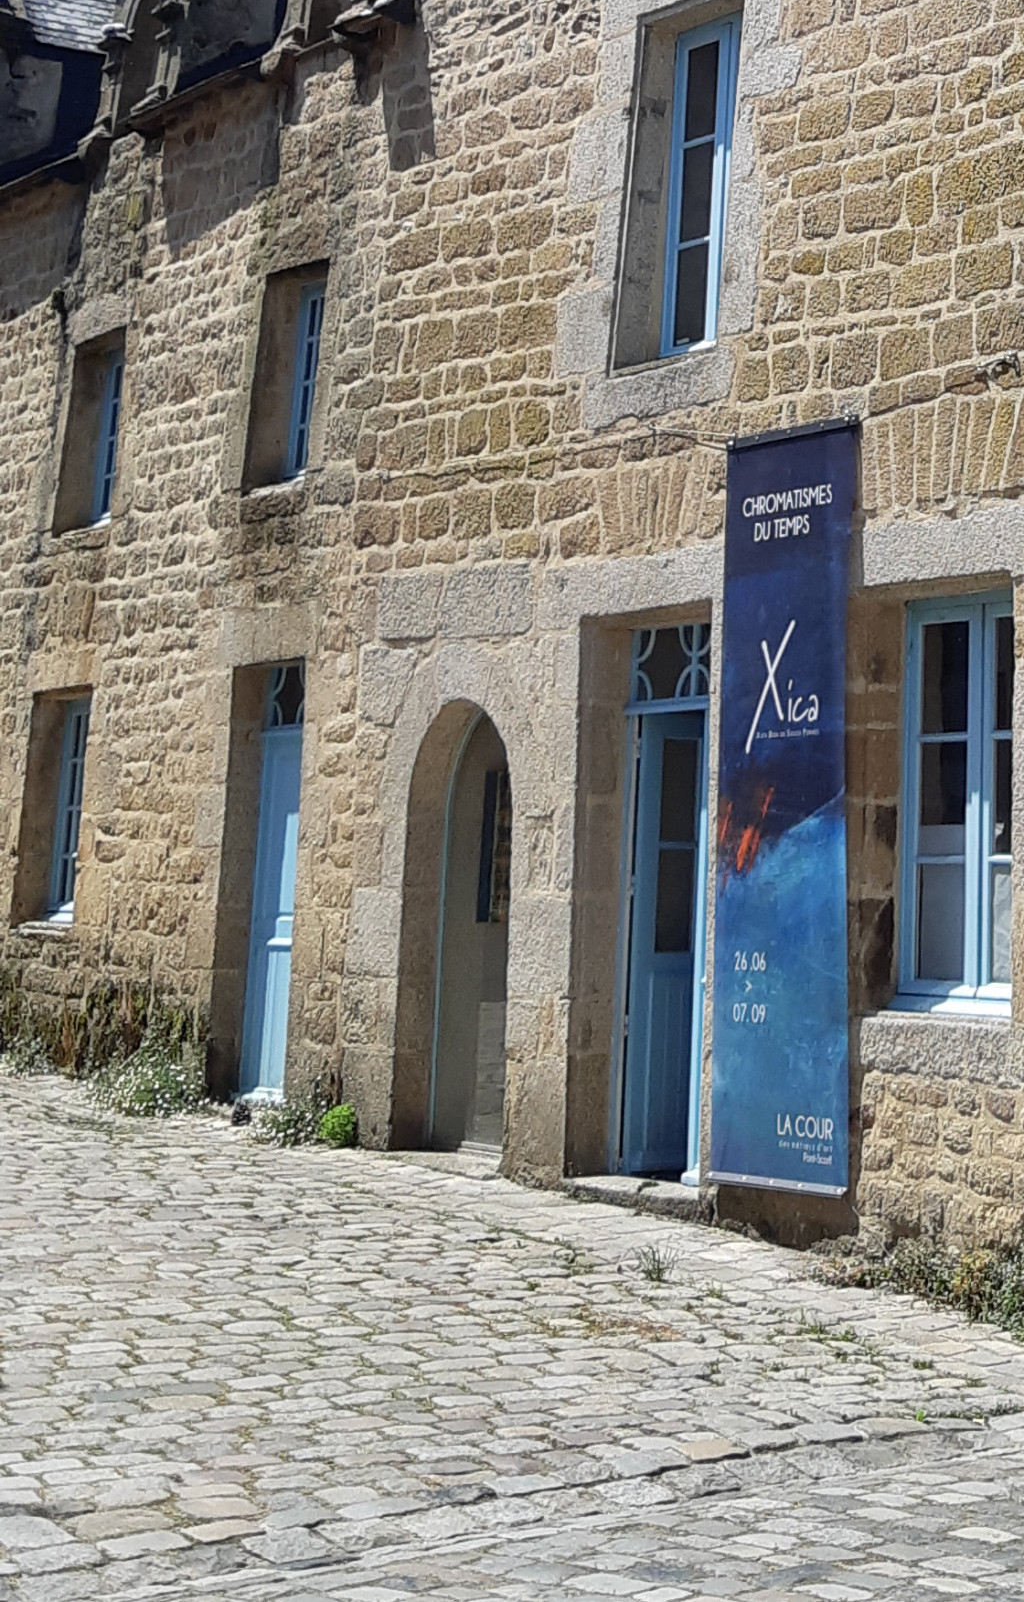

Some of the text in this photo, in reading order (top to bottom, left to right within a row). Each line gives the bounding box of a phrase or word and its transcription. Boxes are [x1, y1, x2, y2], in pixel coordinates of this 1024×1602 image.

[742, 483, 833, 518] CHROMATISMES
[753, 514, 810, 543] DU TEMPS
[745, 619, 819, 755] Xica
[734, 950, 767, 972] 26.06
[732, 1002, 766, 1024] 07.09
[776, 1113, 834, 1140] LA COUR
